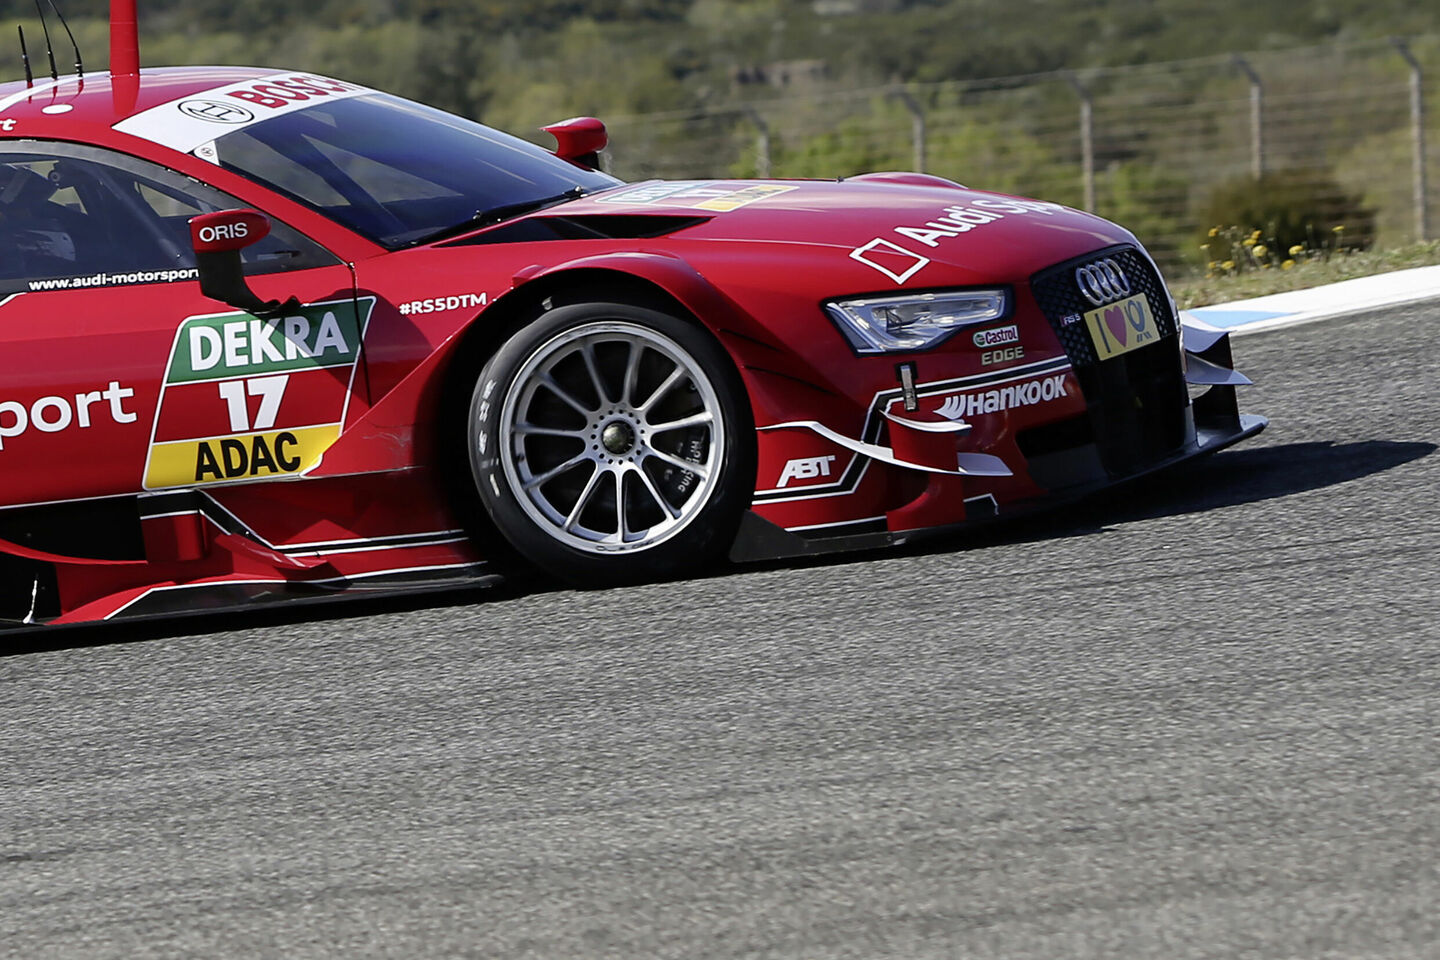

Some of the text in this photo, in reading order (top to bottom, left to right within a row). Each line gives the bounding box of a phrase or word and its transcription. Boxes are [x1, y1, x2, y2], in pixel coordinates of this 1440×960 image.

[199, 222, 248, 242] ORIS
[893, 205, 1005, 248] Audi
[399, 292, 487, 315] #RS5DTM
[189, 311, 350, 371] DEKRA
[985, 327, 1018, 345] Castrol
[981, 346, 1025, 366] EDGE
[218, 375, 290, 432] 17
[195, 432, 301, 481] ADAC
[776, 455, 836, 488] ABT
